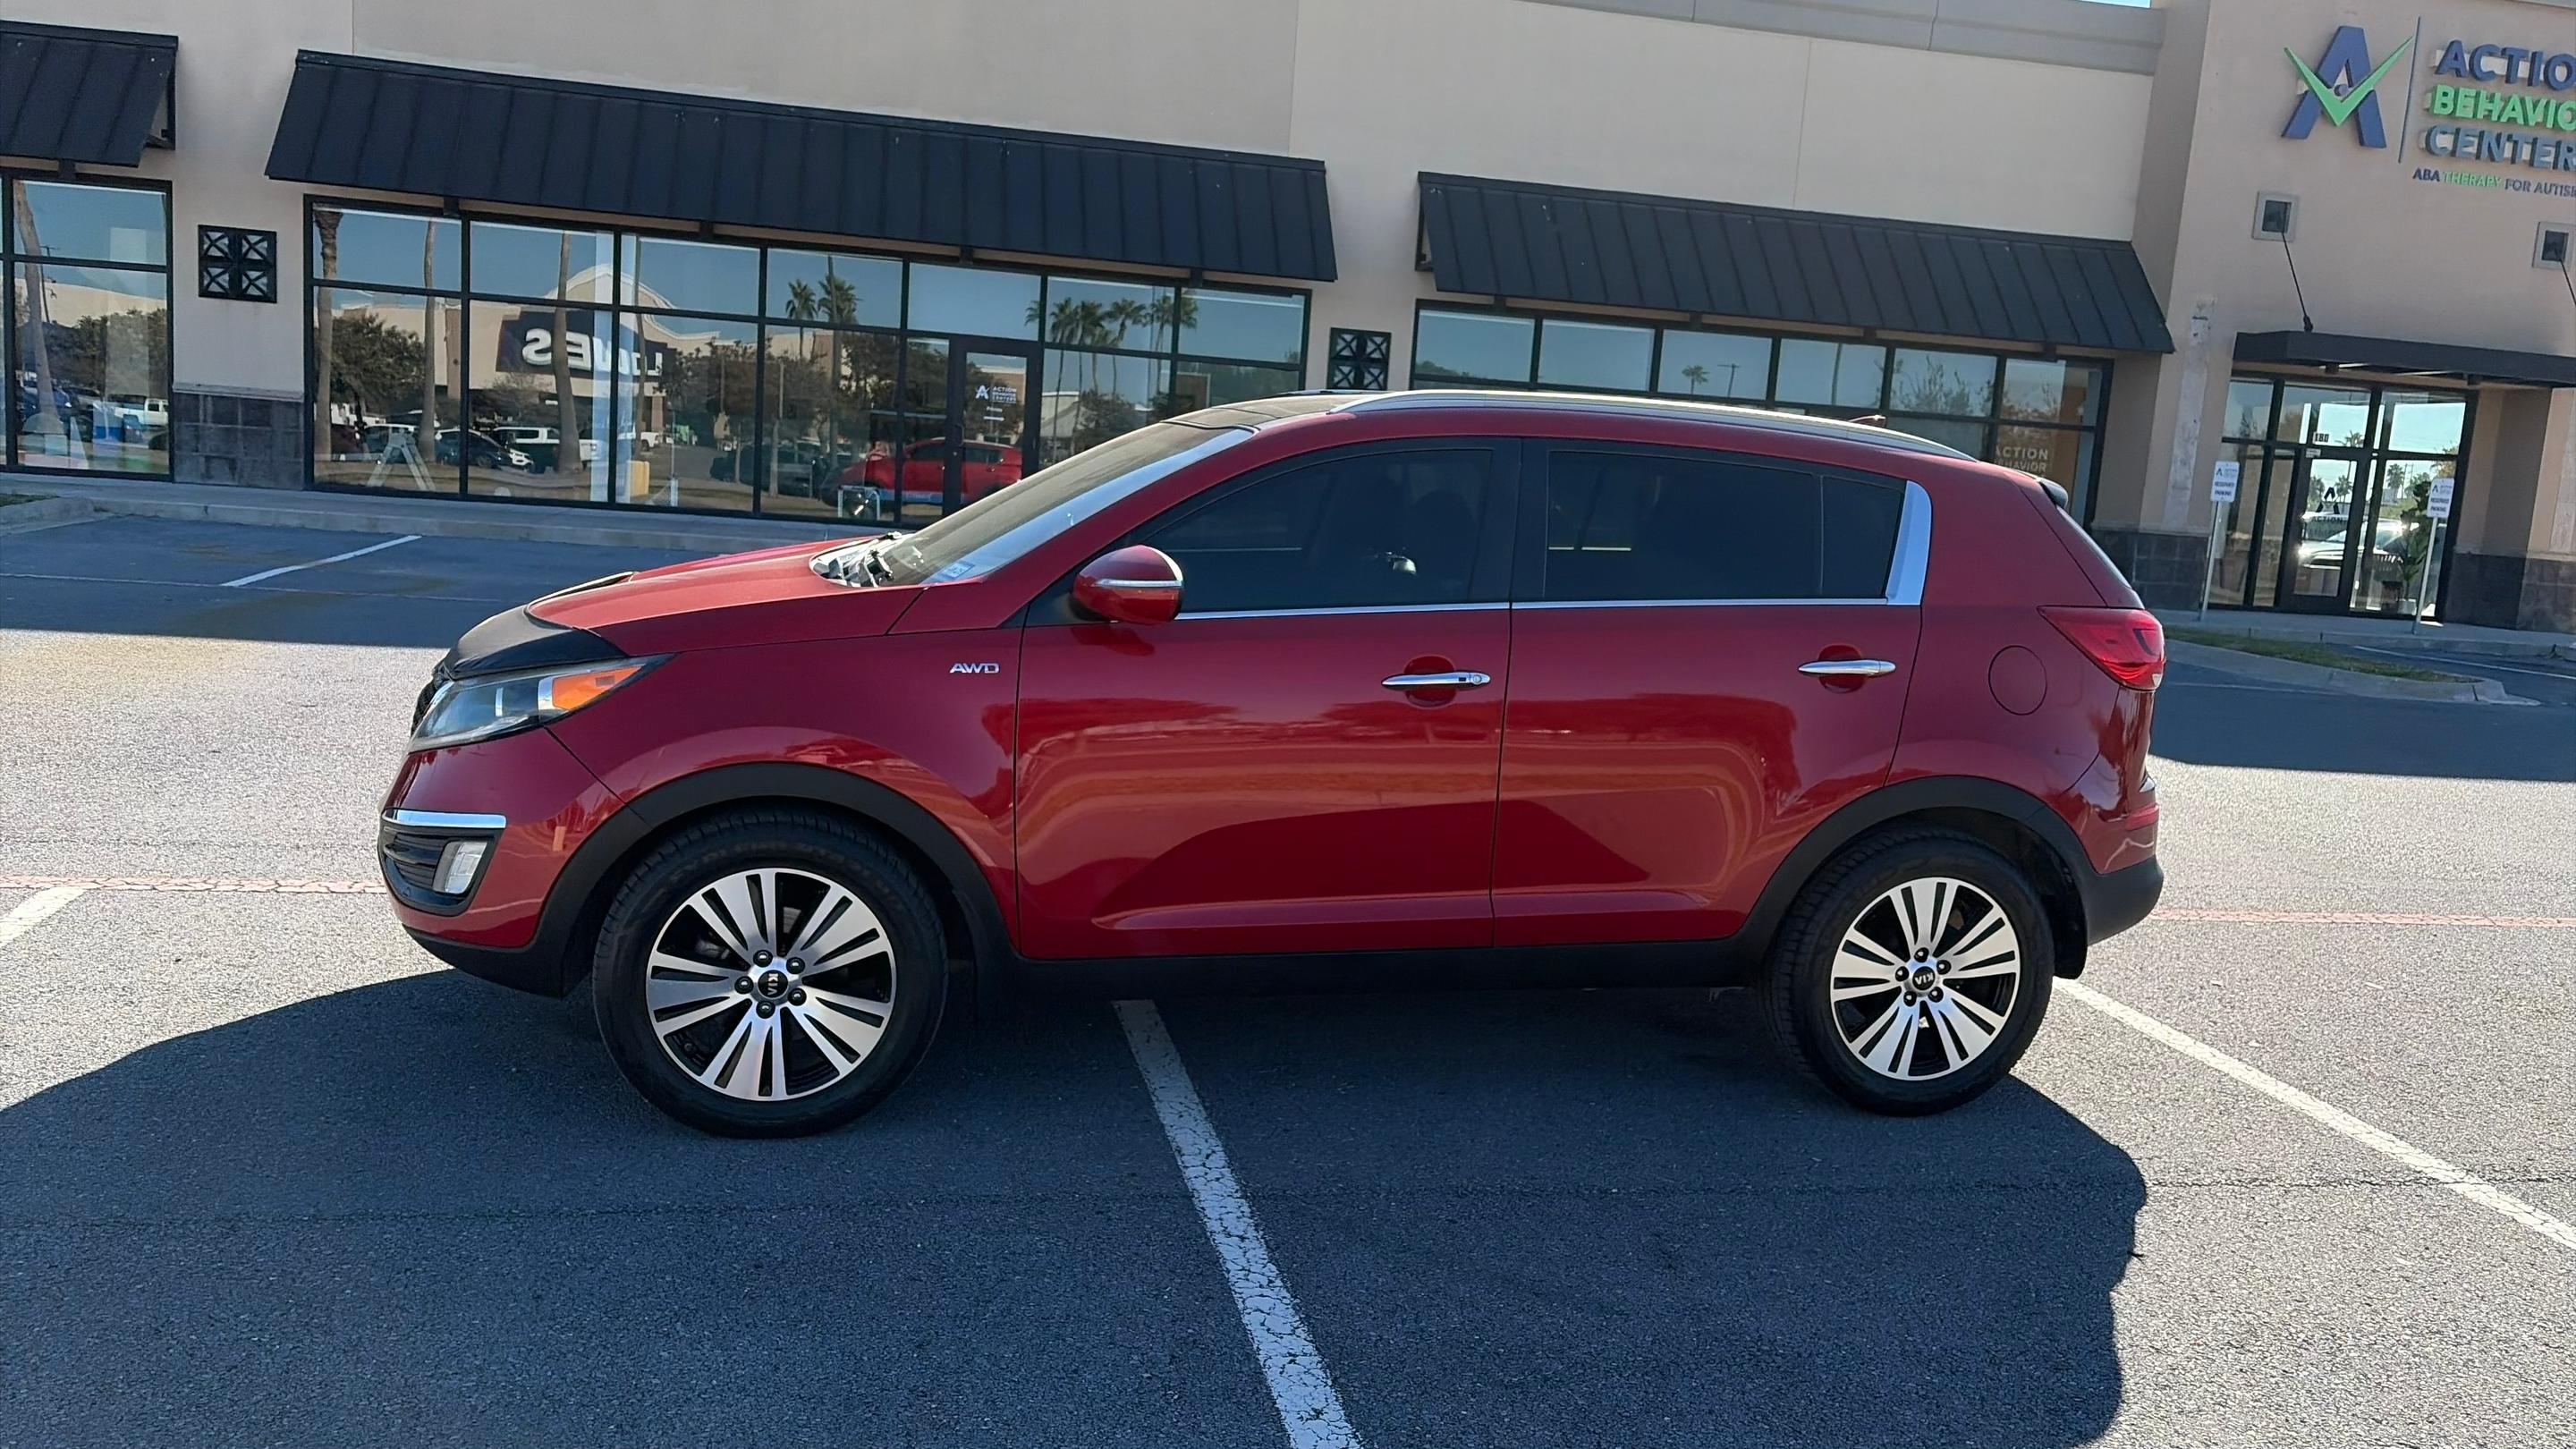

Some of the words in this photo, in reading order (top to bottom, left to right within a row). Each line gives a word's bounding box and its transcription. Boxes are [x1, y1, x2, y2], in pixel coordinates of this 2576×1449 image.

[2435, 39, 2576, 91] ACTIO
[2431, 83, 2576, 131] BEHAVIO
[2425, 123, 2576, 172] CENTER
[2412, 167, 2440, 182] ABA
[2443, 171, 2502, 188] THERAPY
[2504, 178, 2530, 193] FOR
[949, 663, 1000, 674] AWD
[767, 972, 779, 996] KIA
[1914, 972, 1934, 985] KIA
